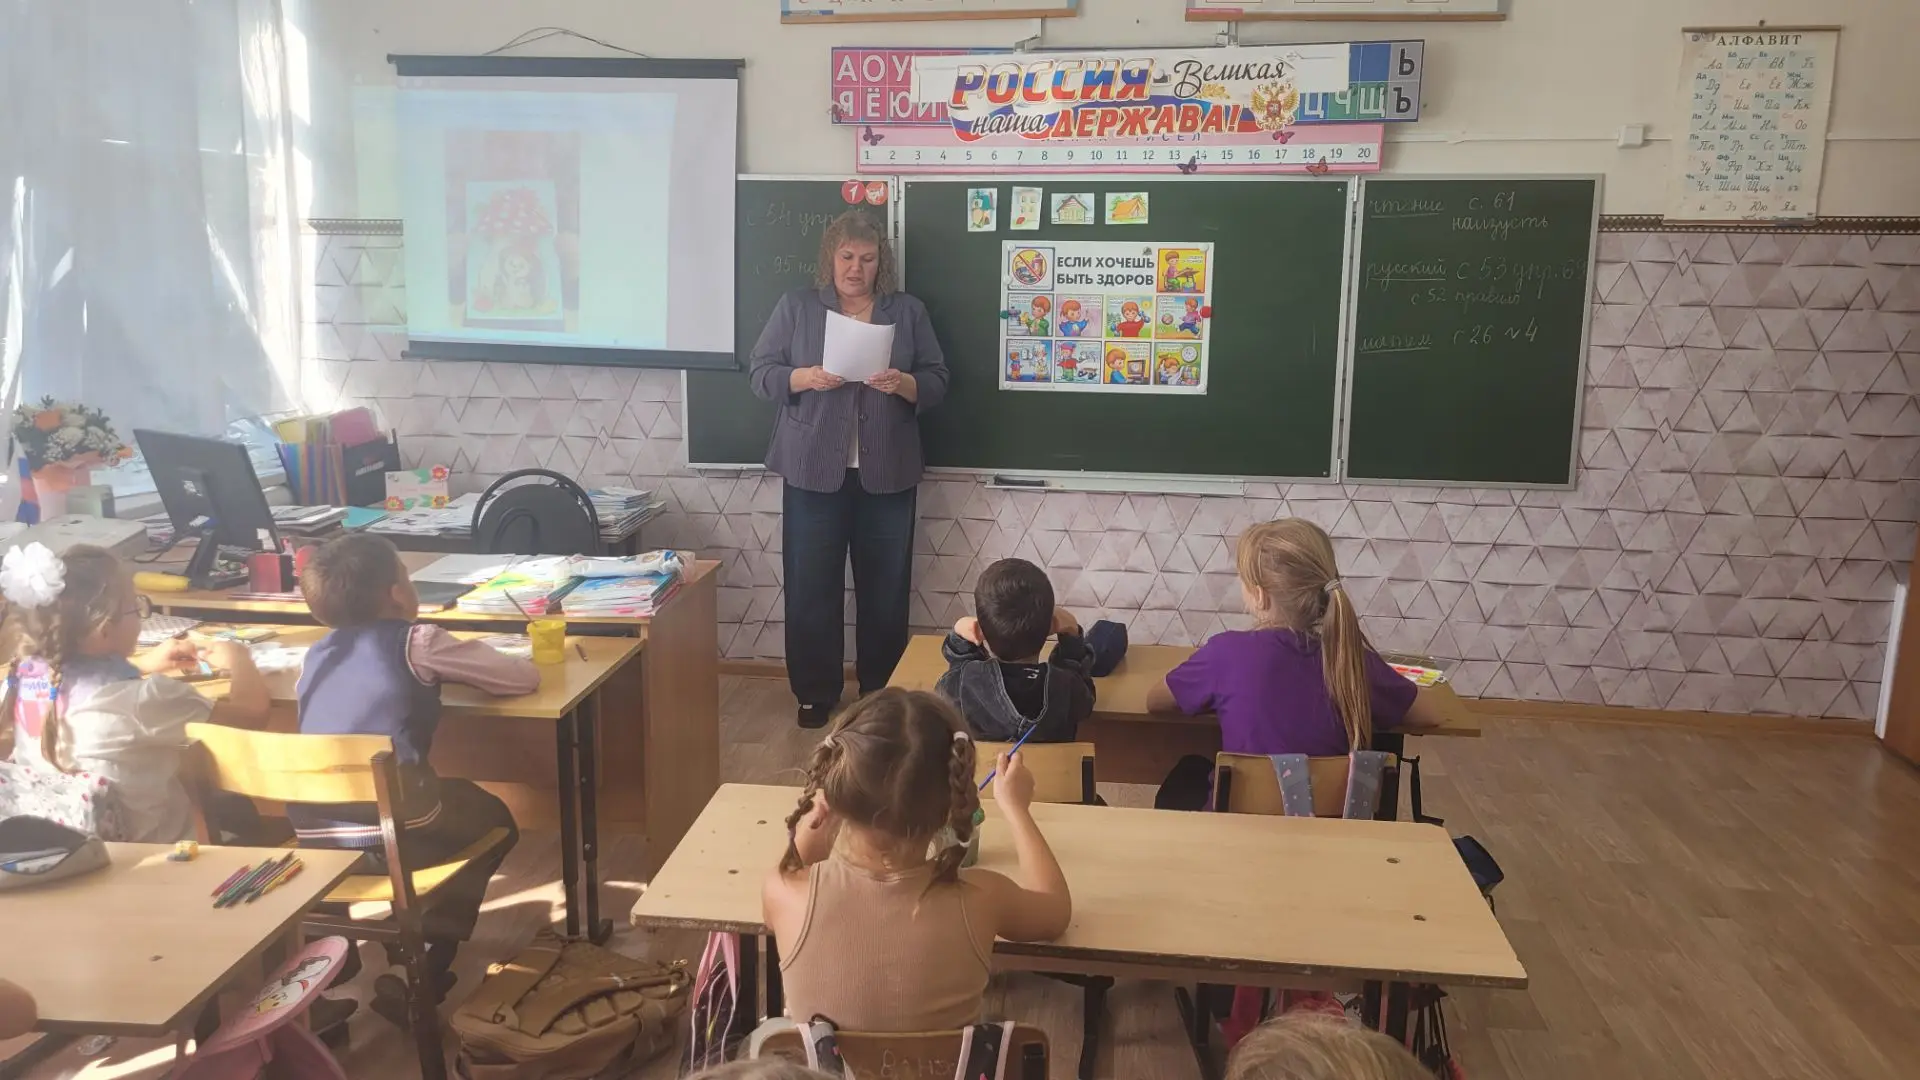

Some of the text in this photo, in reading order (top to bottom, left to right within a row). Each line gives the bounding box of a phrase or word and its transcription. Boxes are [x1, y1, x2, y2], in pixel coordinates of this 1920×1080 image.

[1716, 34, 1802, 46] АЛФАВИТ
[951, 57, 1152, 105] РОССИЯ
[1174, 60, 1287, 98] Великая
[971, 104, 1244, 138] наша ДЕРЖАВА!
[864, 147, 1372, 161] 1 2 3 4 5 6 7 8 9 10 11 12 13 14 15 16 17 18 19 20
[1451, 215, 1550, 241] наизусть
[1056, 256, 1155, 268] ЕСЛИ ХОЧЕШЬ
[1056, 274, 1154, 287] БЫТЬ ЗДОРОВ
[1366, 258, 1447, 290] русский
[1469, 324, 1495, 345] 26
